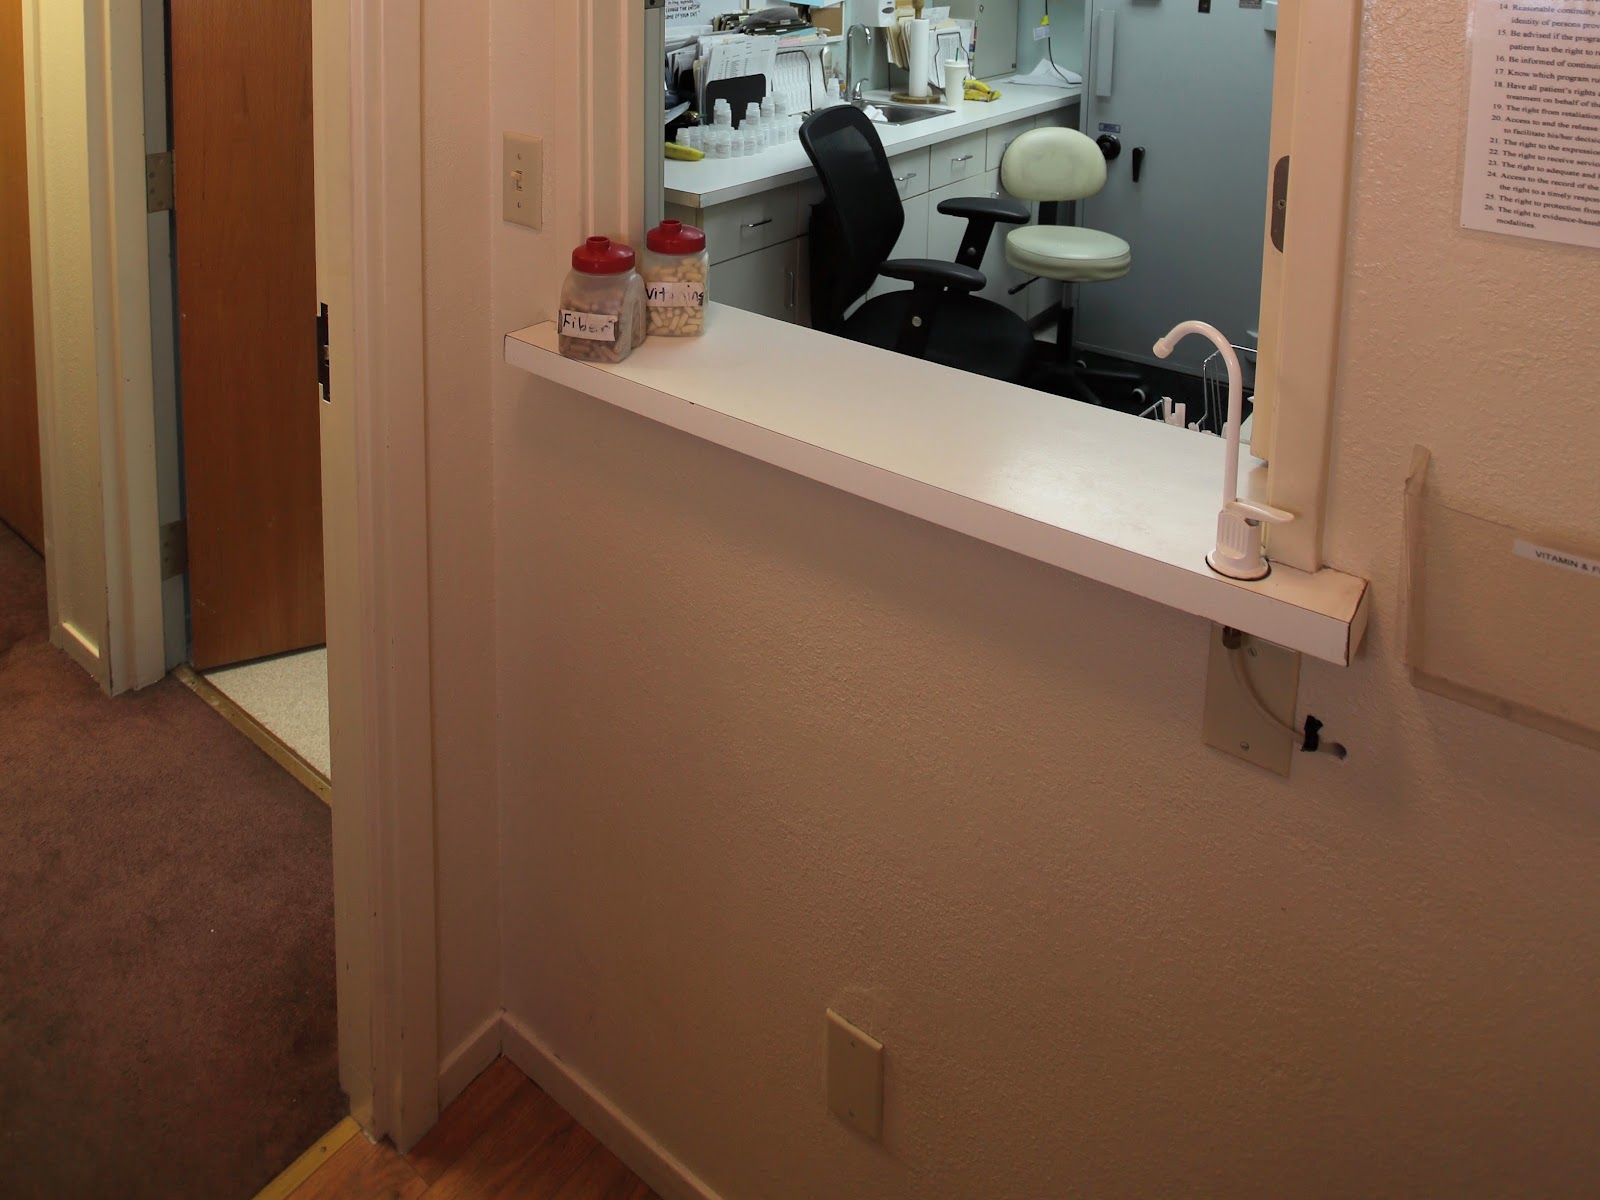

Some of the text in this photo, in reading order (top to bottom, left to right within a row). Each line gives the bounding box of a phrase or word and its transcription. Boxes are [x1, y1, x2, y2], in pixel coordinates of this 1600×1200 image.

[1512, 4, 1596, 16] Reasonable continuity
[1511, 17, 1539, 26] identity
[1523, 31, 1551, 39] advised
[1521, 56, 1555, 66] informed
[1508, 69, 1589, 82] Know which program
[1507, 82, 1526, 90] Have
[1540, 86, 1572, 94] patient's
[1574, 89, 1596, 97] rights
[1506, 94, 1541, 102] treatment
[1522, 106, 1539, 114] right
[1505, 116, 1530, 124] Access
[1513, 129, 1545, 138] facilitate
[1519, 141, 1537, 149] right
[1518, 152, 1536, 160] right
[1501, 161, 1516, 169] The
[1546, 169, 1580, 177] adequate
[1501, 173, 1526, 182] Access
[1551, 180, 1575, 188] record
[1587, 183, 1599, 191] the
[1512, 186, 1530, 194] right
[1547, 191, 1572, 200] timely
[1514, 197, 1532, 205] right
[1543, 202, 1581, 212] protection
[1498, 206, 1512, 214] The
[1513, 209, 1531, 217] right
[1535, 550, 1578, 568] VITAMIN
